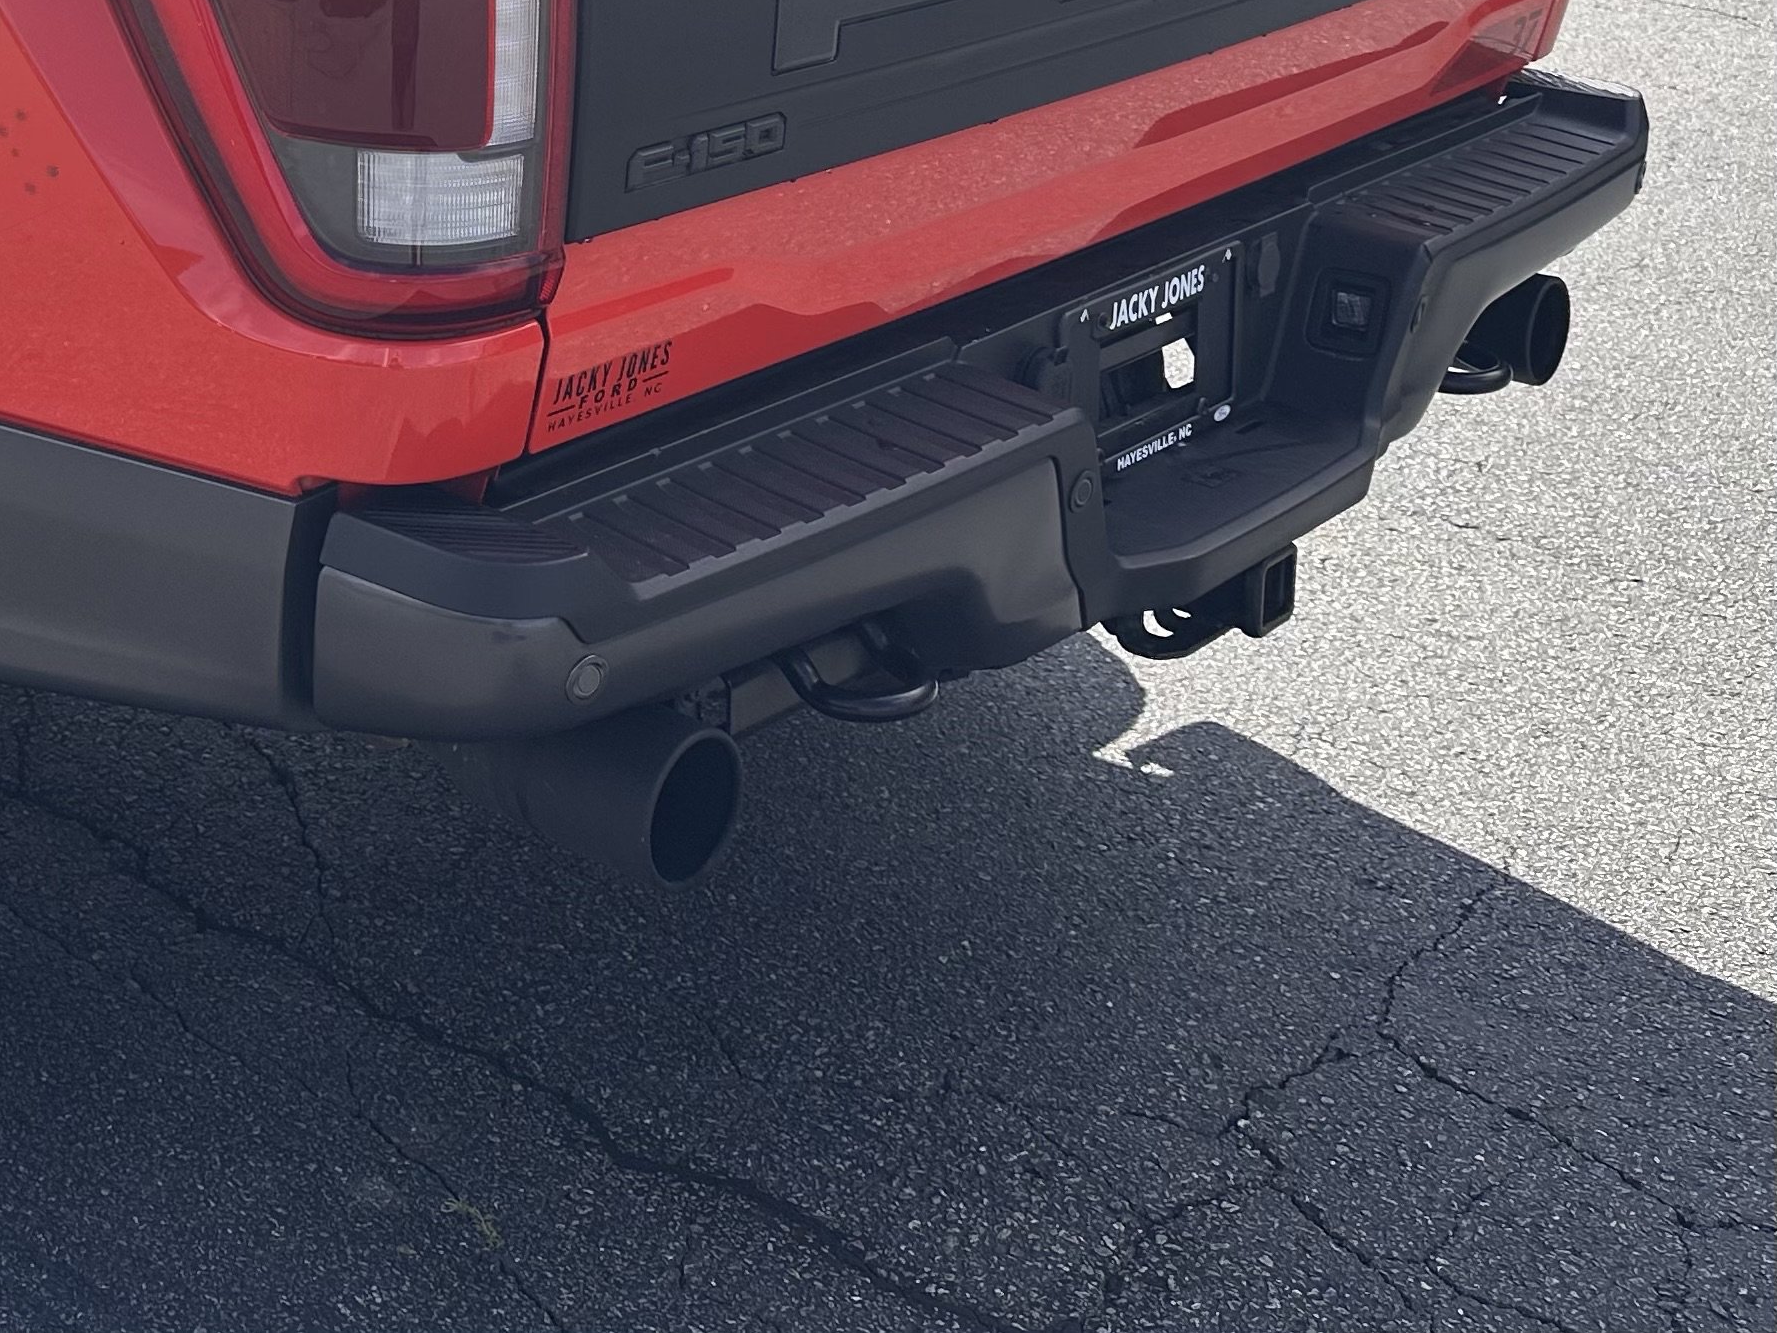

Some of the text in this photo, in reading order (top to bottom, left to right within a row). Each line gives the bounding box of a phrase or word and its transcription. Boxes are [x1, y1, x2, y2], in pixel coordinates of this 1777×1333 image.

[624, 111, 787, 193] F-150
[1109, 264, 1205, 330] JACKY JONES
[552, 338, 672, 405] JACKY JONES
[578, 377, 638, 409] FORD
[644, 382, 663, 397] NC
[1117, 423, 1193, 471] HAYESVILLE, NC
